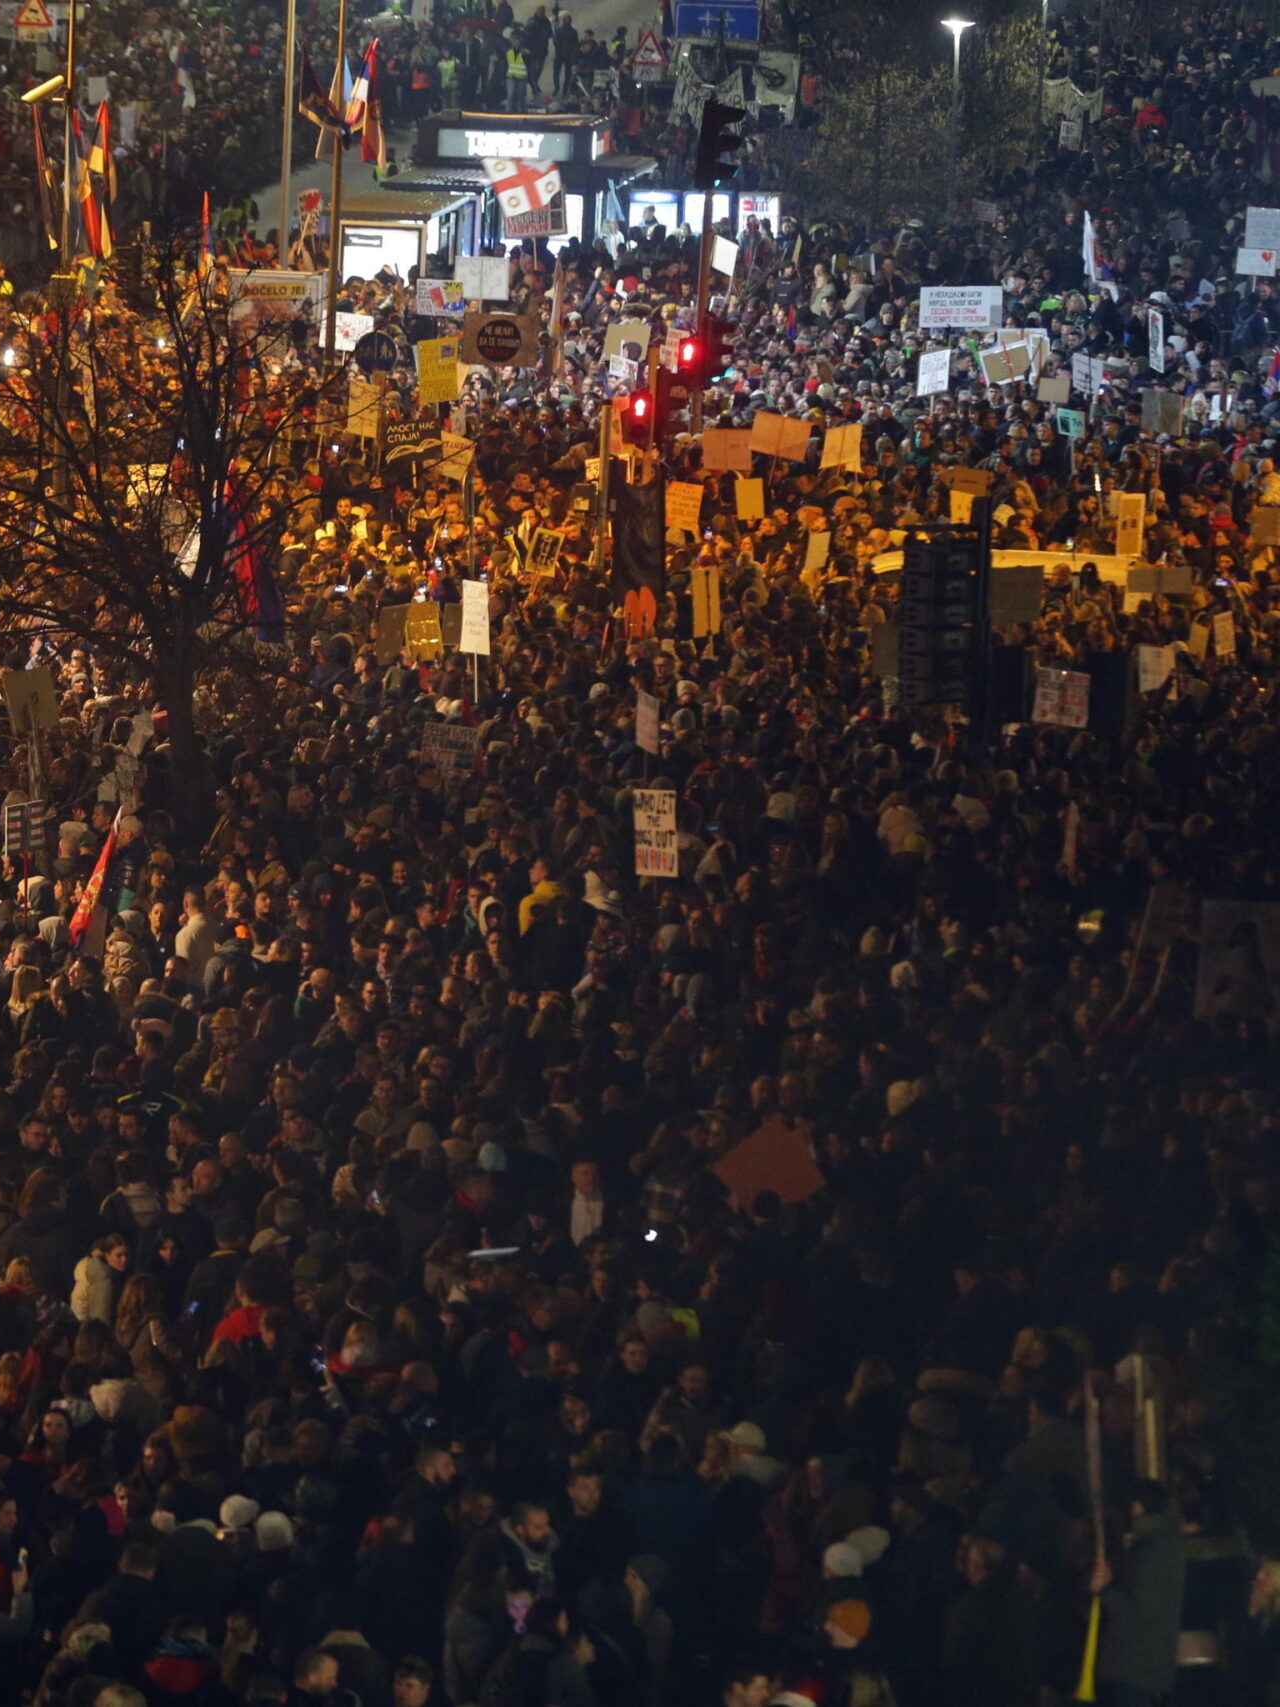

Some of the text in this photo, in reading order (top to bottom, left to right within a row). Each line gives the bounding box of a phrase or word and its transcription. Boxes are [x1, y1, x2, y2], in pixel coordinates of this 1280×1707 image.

[387, 421, 435, 434] МОСТ НАС
[387, 432, 420, 443] СПАЈА!
[656, 792, 675, 814] LET
[656, 829, 675, 848] OUT
